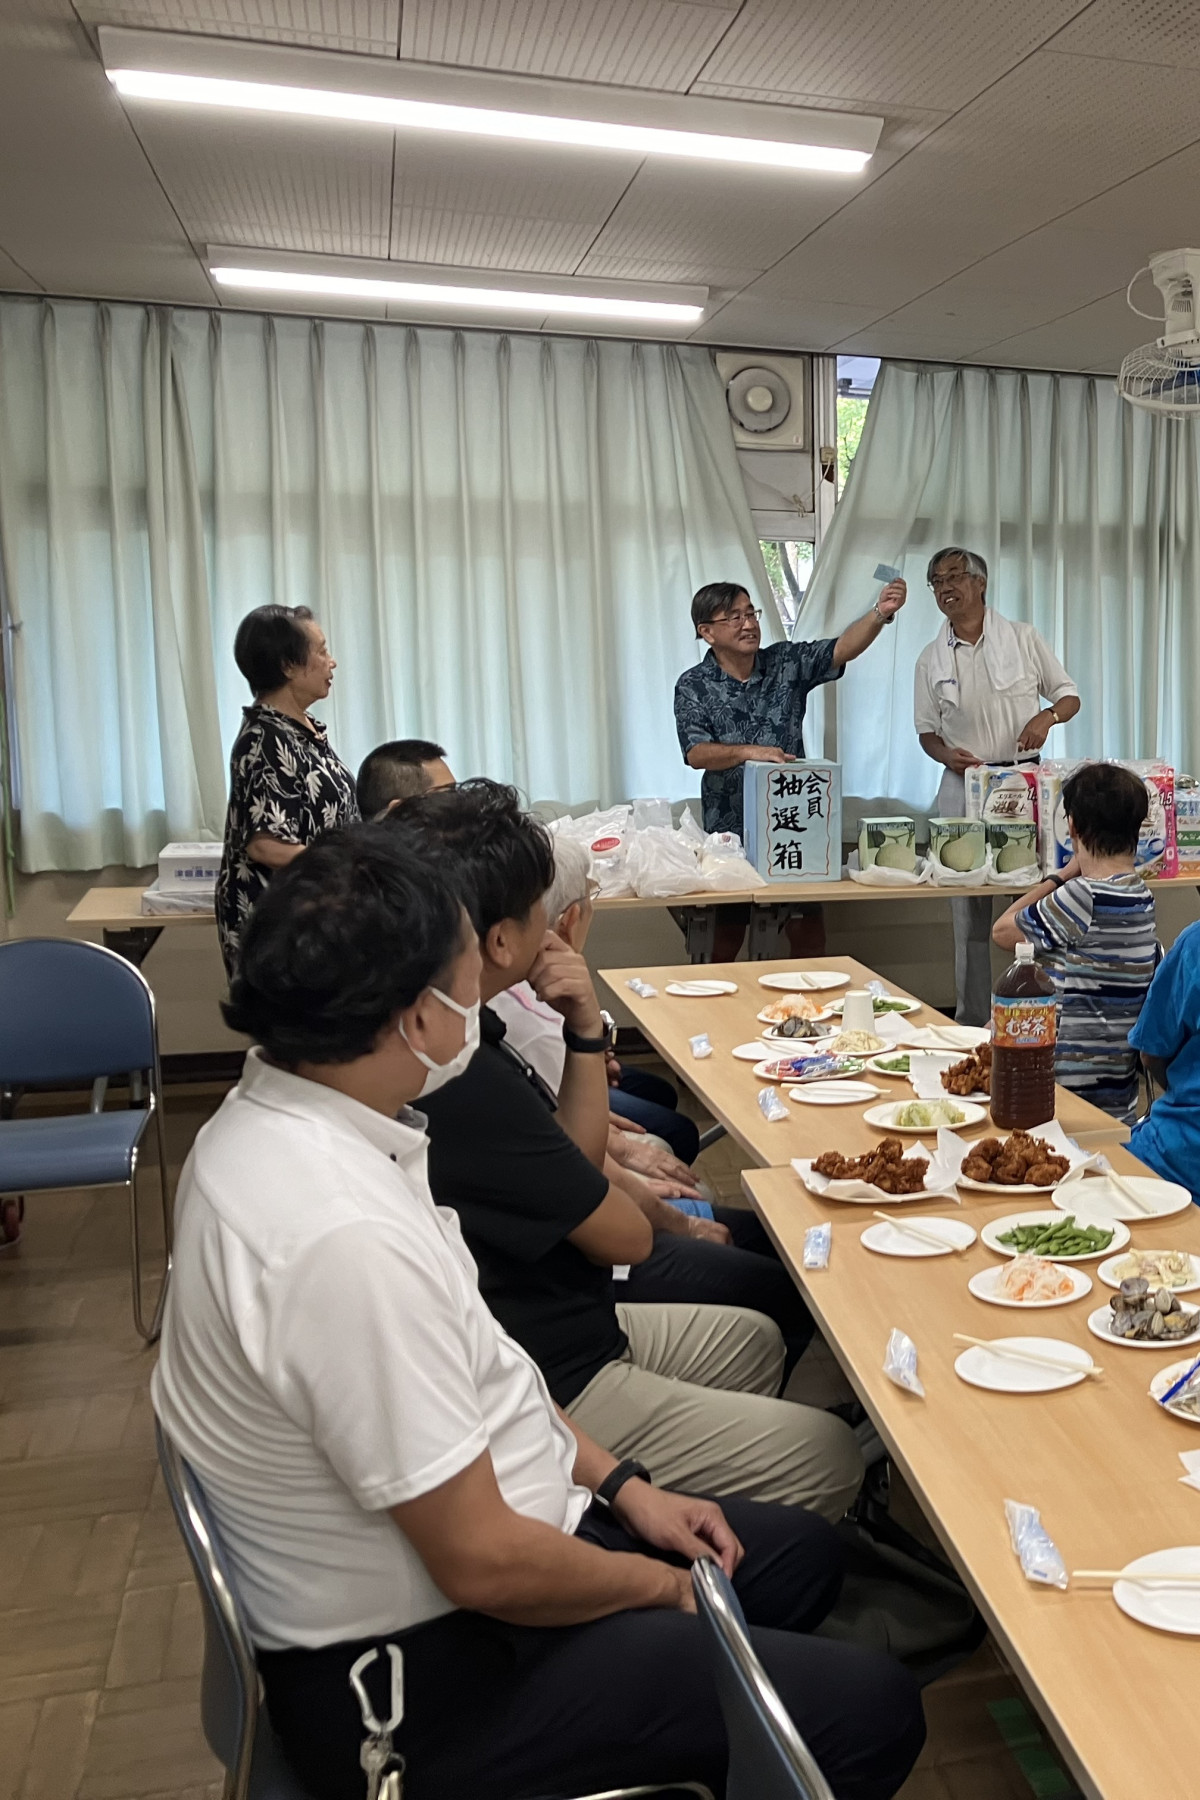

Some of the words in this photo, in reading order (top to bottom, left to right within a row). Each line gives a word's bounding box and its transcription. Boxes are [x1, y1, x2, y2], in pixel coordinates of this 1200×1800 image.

[803, 771, 829, 820] 会員
[1159, 791, 1172, 805] 1.5
[772, 773, 807, 870] 抽選箱
[1005, 1015, 1047, 1037] むぎ茶
